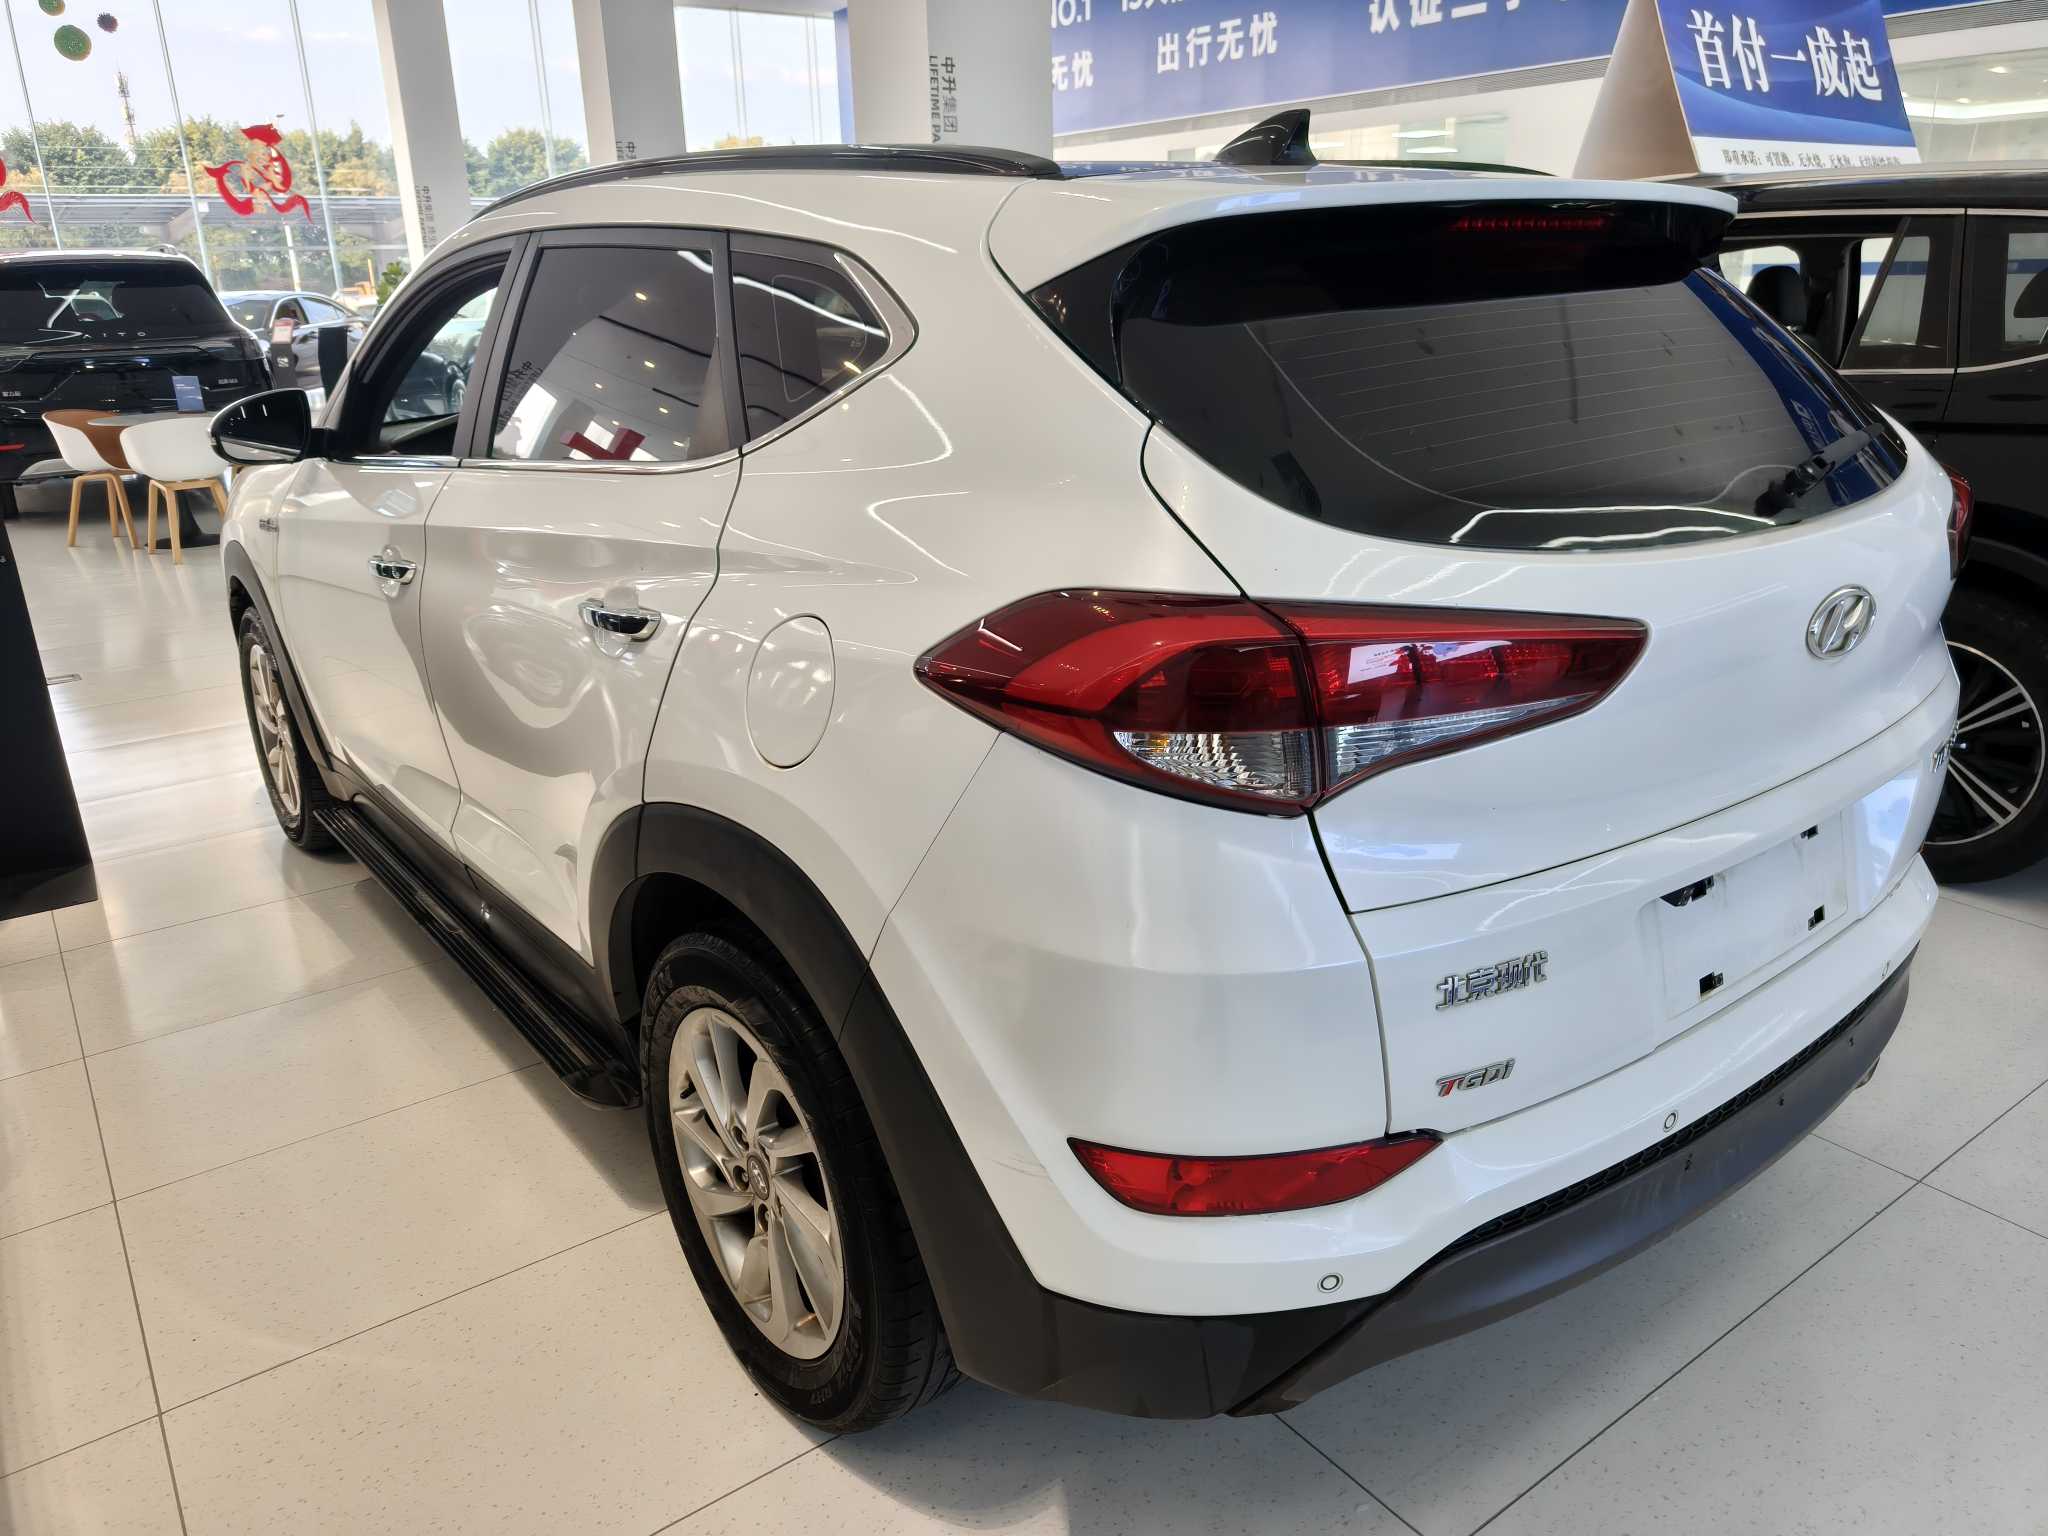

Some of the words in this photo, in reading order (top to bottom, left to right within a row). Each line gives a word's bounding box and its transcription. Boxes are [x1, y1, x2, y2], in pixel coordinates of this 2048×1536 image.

[1157, 11, 1278, 74] 出行无忧
[1686, 9, 1883, 101] 首付一成起
[929, 56, 941, 120] LIFETIME
[941, 56, 958, 133] 中升集团
[1435, 951, 1549, 1010] 北京现代
